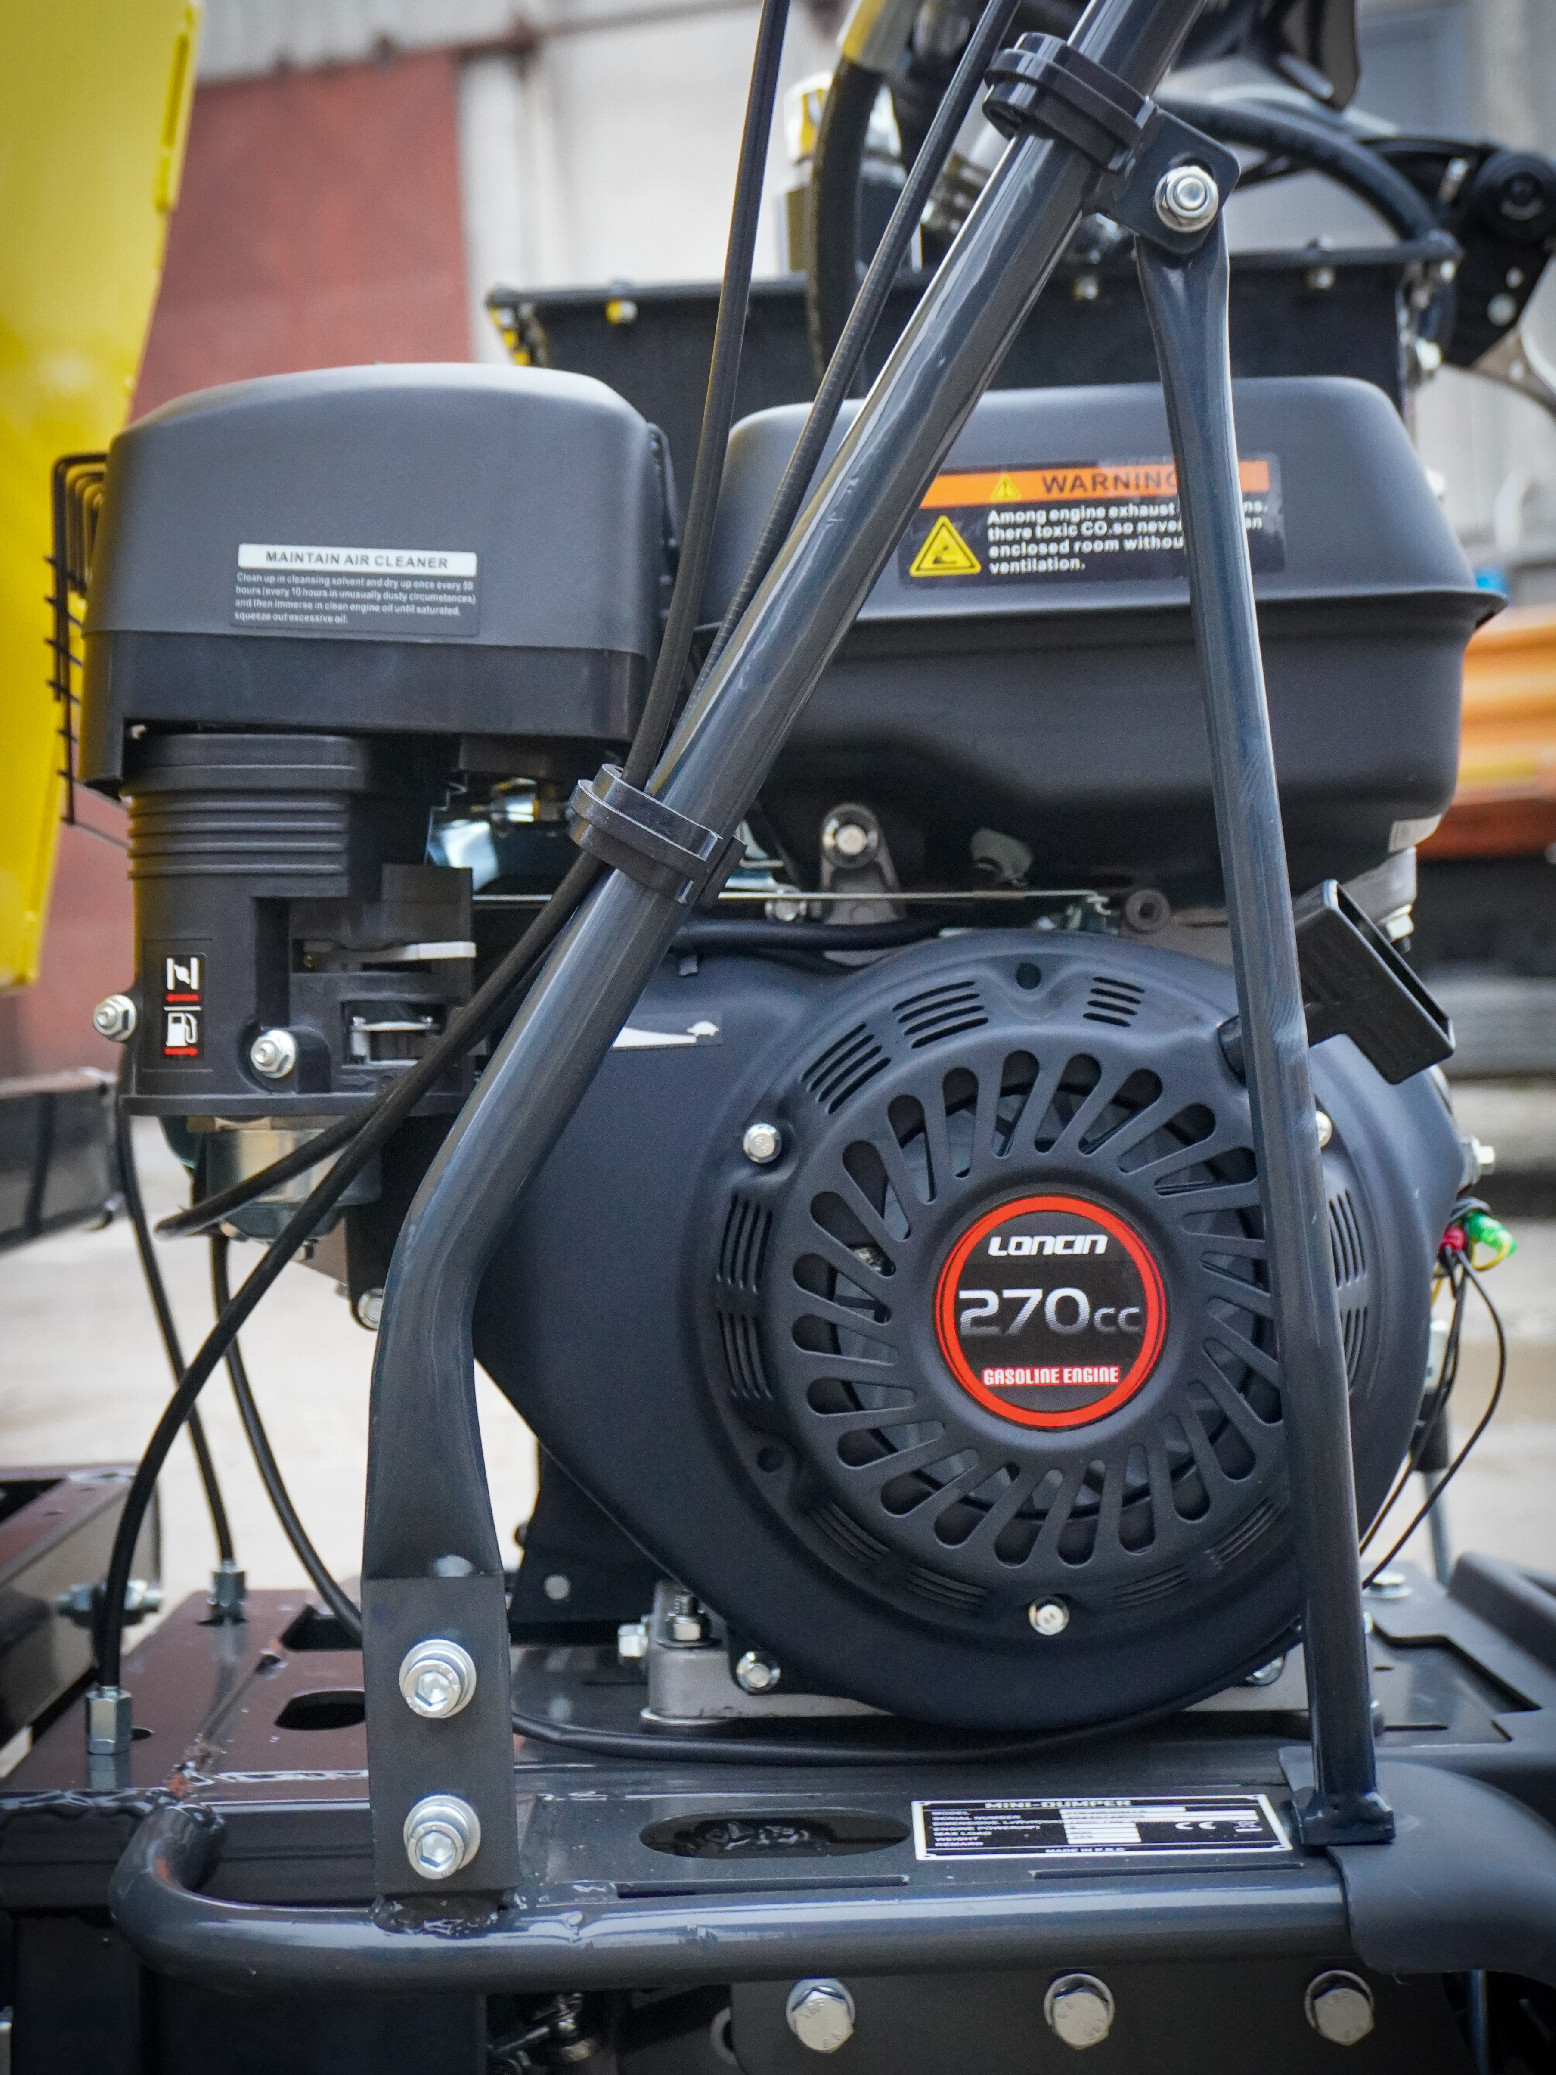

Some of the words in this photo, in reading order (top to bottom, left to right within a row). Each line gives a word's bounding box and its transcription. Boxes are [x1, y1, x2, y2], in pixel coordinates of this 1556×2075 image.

[987, 510, 1047, 526] Among
[1048, 505, 1106, 523] engine
[1108, 502, 1175, 519] exhaust
[987, 526, 1032, 542] there
[1035, 522, 1078, 539] toxic
[988, 539, 1070, 559] enclosed
[1073, 539, 1120, 554] room
[1123, 535, 1184, 553] withou
[265, 550, 340, 564] MAINTAIN
[343, 553, 370, 566] AIR
[374, 554, 448, 569] CLEANER
[988, 556, 1086, 575] ventilation.
[236, 571, 262, 584] Clean
[264, 574, 275, 585] up
[277, 574, 286, 584] in
[287, 574, 330, 587] cleansing
[332, 576, 364, 587] solvent
[366, 577, 384, 587] and
[384, 577, 399, 590] dry
[400, 580, 412, 591] up
[413, 580, 435, 590] once
[436, 581, 461, 592] every
[235, 585, 262, 596] hours
[302, 587, 328, 597] hours
[329, 588, 338, 598] in
[339, 589, 382, 601] unusually
[383, 590, 408, 603] dusty
[234, 599, 252, 608] and
[253, 599, 273, 609] then
[274, 599, 313, 610] immerse
[315, 600, 323, 610] in
[324, 601, 349, 611] clean
[350, 603, 380, 614] engine
[381, 603, 393, 613] oil
[394, 604, 415, 614] until
[234, 611, 271, 622] squeeze
[272, 612, 288, 622] out
[288, 612, 333, 624] excessive
[983, 1367, 1060, 1386] GASOLINE
[1062, 1366, 1119, 1384] ENGINE
